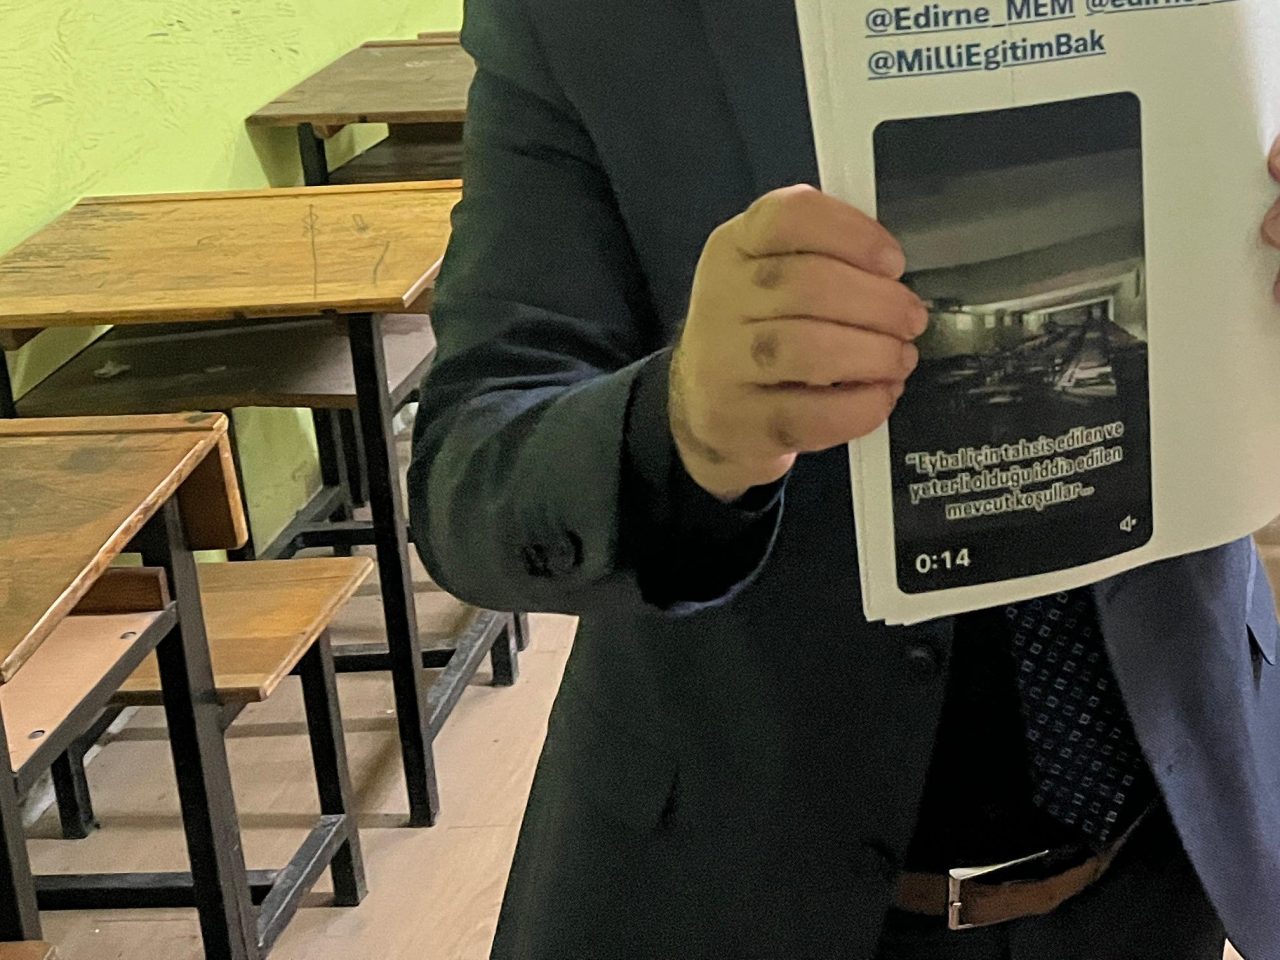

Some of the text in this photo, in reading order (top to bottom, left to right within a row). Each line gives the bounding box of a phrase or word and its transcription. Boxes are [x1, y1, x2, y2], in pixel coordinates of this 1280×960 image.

[868, 29, 1106, 76] @MilliEgitimBak
[1000, 434, 1056, 463] tahsis
[1103, 420, 1125, 440] ve
[1033, 455, 1075, 480] iddia
[1075, 445, 1124, 472] edilen
[946, 496, 1013, 520] mevcut
[915, 547, 971, 574] 0:14
